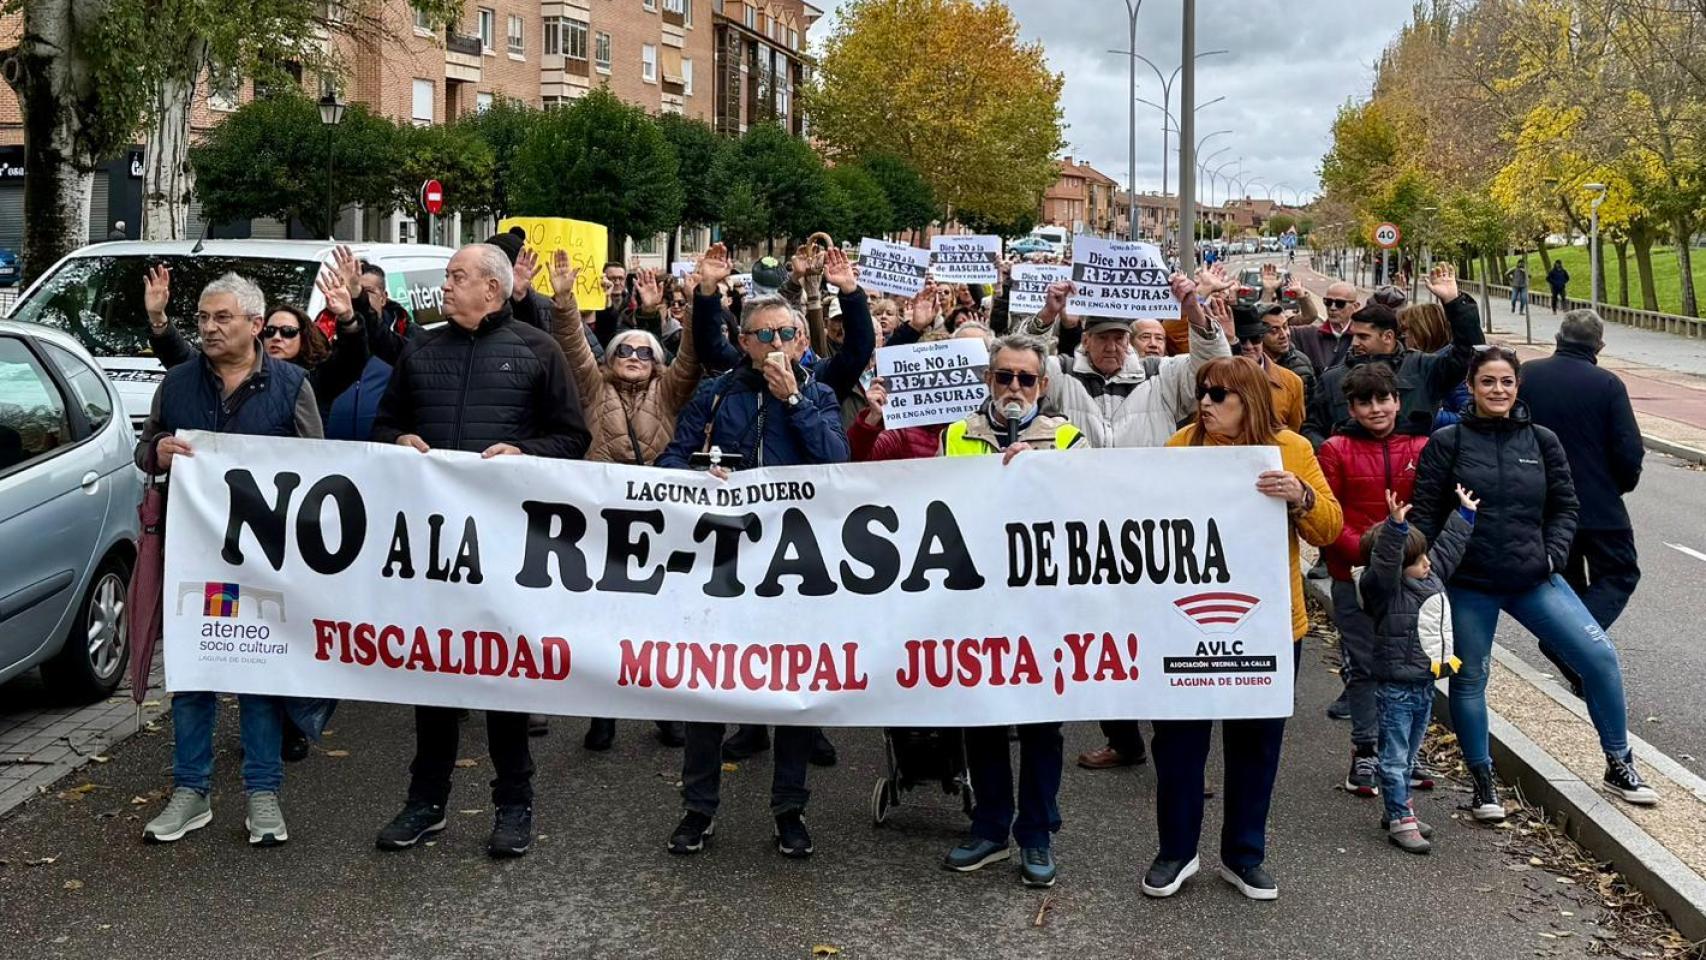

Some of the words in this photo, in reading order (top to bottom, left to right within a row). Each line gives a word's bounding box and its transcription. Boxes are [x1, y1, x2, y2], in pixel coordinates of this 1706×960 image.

[1378, 230, 1395, 239] 40
[870, 247, 888, 259] Dice
[890, 251, 901, 261] NO
[939, 243, 956, 251] Dice
[958, 243, 970, 252] NO
[937, 253, 990, 262] RETASA
[1089, 251, 1114, 267] Dice
[1119, 256, 1138, 268] NO
[1140, 259, 1147, 268] a
[865, 256, 918, 276] RETASA
[949, 264, 991, 272] BASURAS
[875, 271, 918, 286] BASURAS
[1041, 273, 1053, 281] NO
[1082, 266, 1168, 285] RETASA
[1079, 286, 1094, 297] de
[1101, 287, 1170, 300] BASURAS
[1148, 303, 1178, 312] ESTAFA
[893, 360, 920, 374] Dice
[924, 356, 944, 370] NO
[947, 359, 955, 367] a
[957, 355, 969, 366] la
[890, 368, 979, 391] RETASA
[891, 396, 907, 407] de
[913, 387, 985, 406] BASURAS
[946, 406, 961, 414] POR
[963, 404, 979, 412] EST
[626, 481, 711, 507] LAGUNA
[717, 488, 743, 507] DE
[746, 481, 816, 504] DUERO
[221, 468, 368, 575] NO
[382, 510, 415, 579] A
[425, 513, 484, 584] LA
[515, 500, 986, 598] RE-TASA
[1005, 520, 1058, 587] DE
[1065, 517, 1231, 585] BASURA
[201, 620, 270, 640] ateneo
[200, 641, 234, 652] socio
[239, 641, 288, 655] cultural
[1195, 640, 1244, 656] AVLC
[312, 618, 572, 681] FISCALIDAD
[617, 639, 868, 692] MUNICIPAL
[896, 635, 1043, 688] JUSTA
[1053, 632, 1139, 695] ¡YA!
[1241, 660, 1250, 668] LA
[1250, 660, 1271, 668] CALLE
[1170, 677, 1215, 687] LAGUNA
[1218, 677, 1232, 686] DE
[1235, 676, 1272, 686] DUERO
